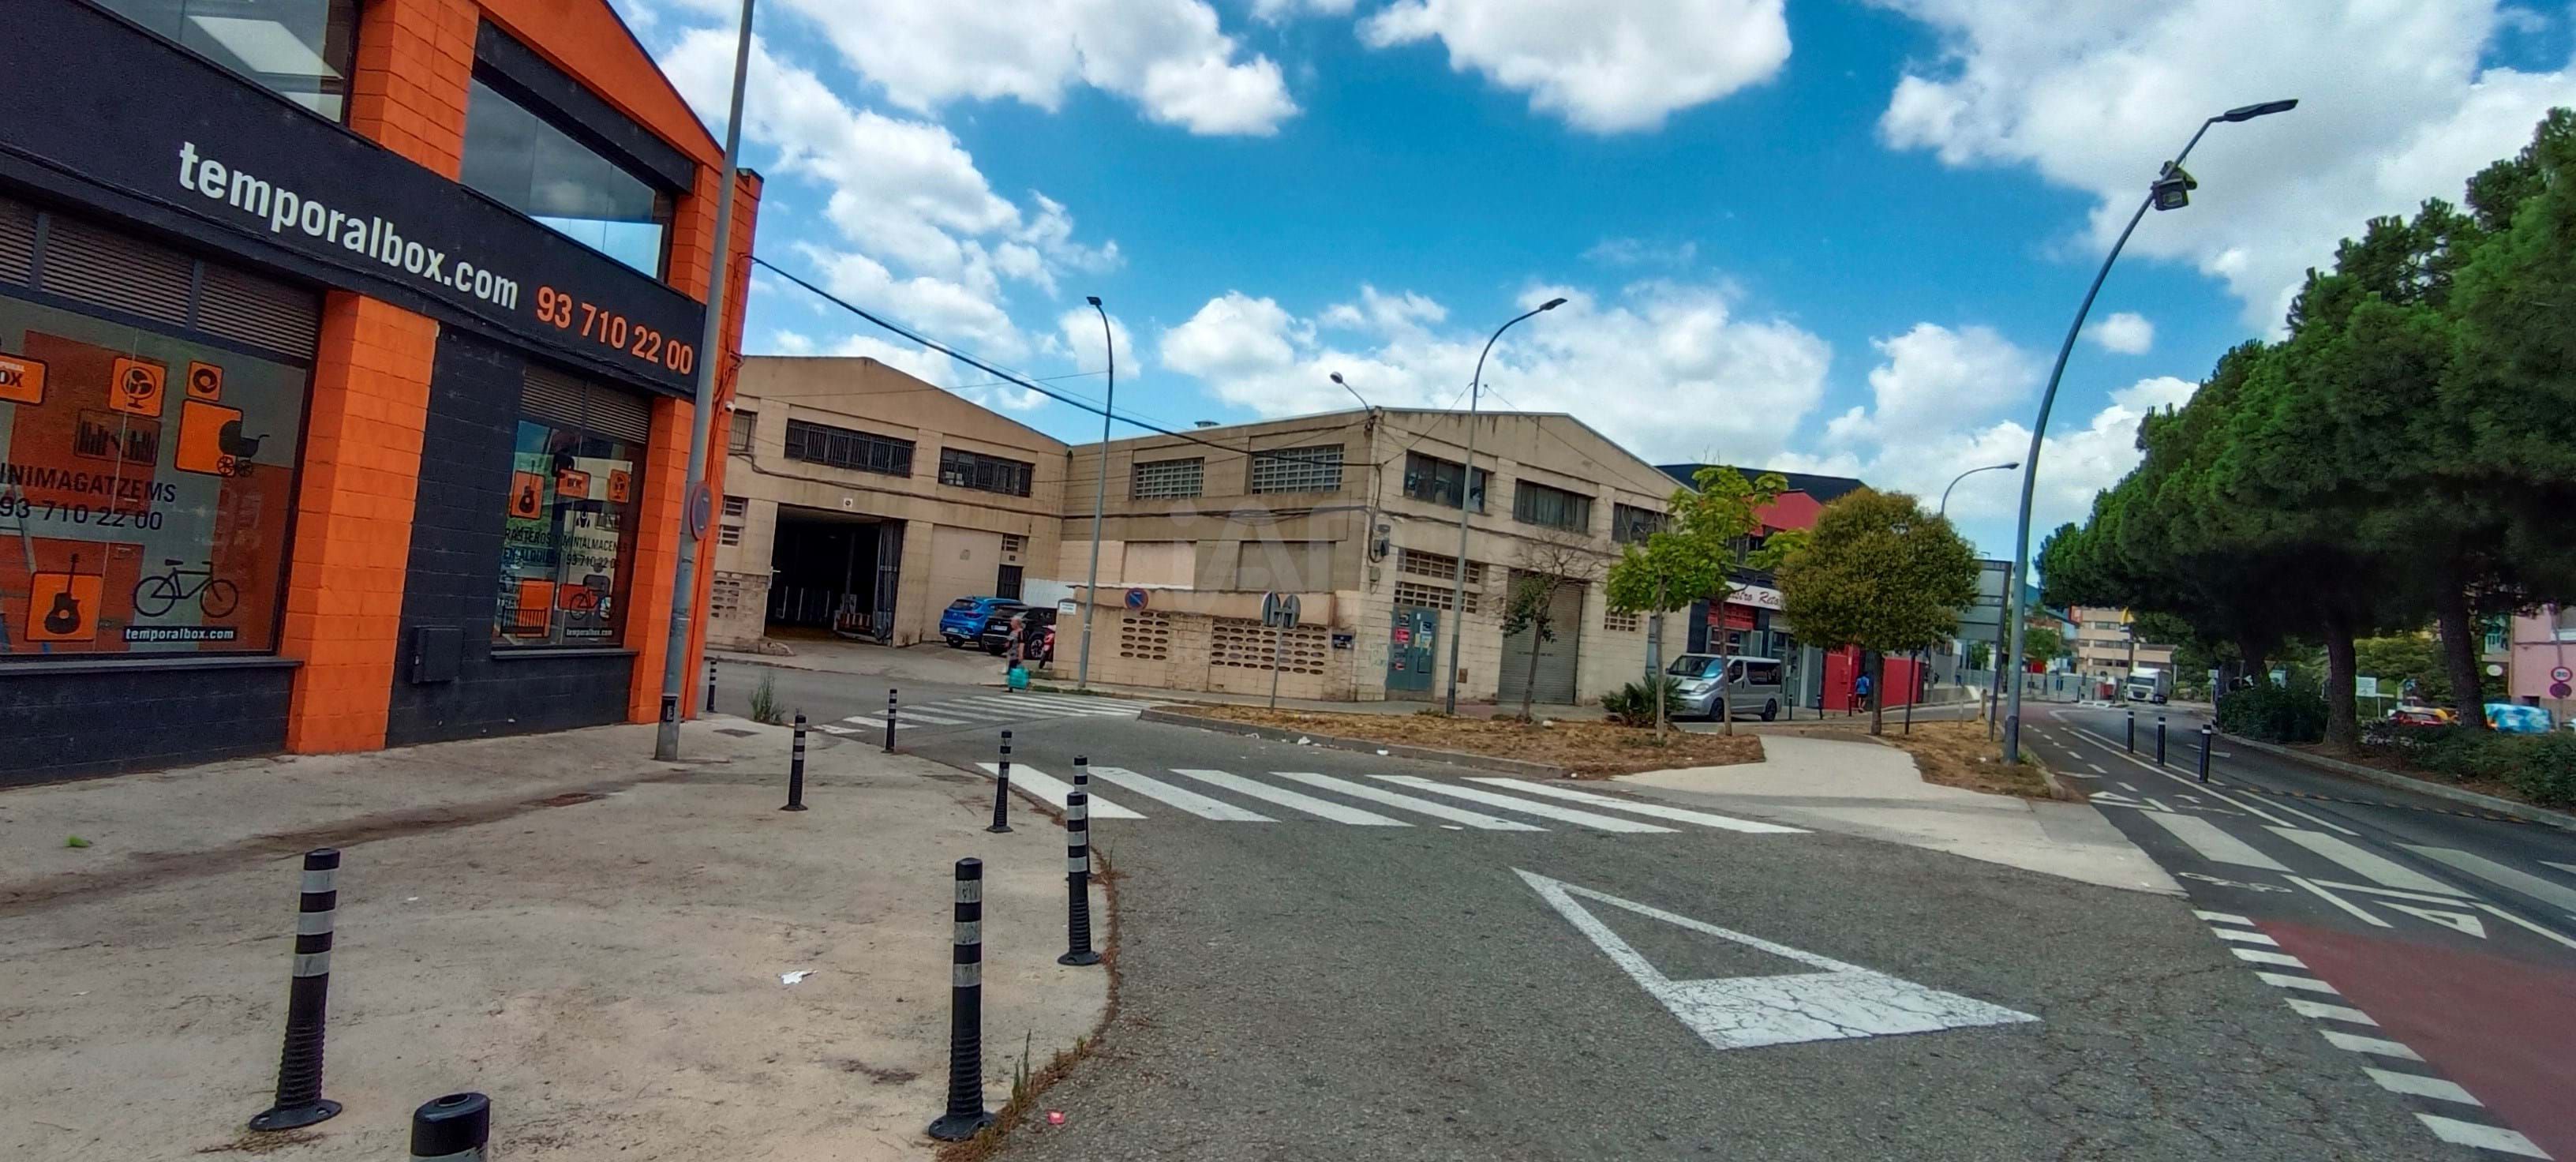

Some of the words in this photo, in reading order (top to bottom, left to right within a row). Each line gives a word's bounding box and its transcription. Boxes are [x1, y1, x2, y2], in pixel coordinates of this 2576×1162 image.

[179, 141, 519, 310] temporalbox.com
[537, 286, 573, 328] 93
[581, 302, 628, 349] 710
[631, 325, 662, 364] 22
[666, 339, 694, 375] 00
[0, 496, 31, 519] 93
[42, 500, 89, 524] 710
[96, 506, 125, 527] 22
[134, 511, 163, 530] 00
[505, 527, 552, 545] RASTEROS
[125, 628, 234, 642] temporalbox.com
